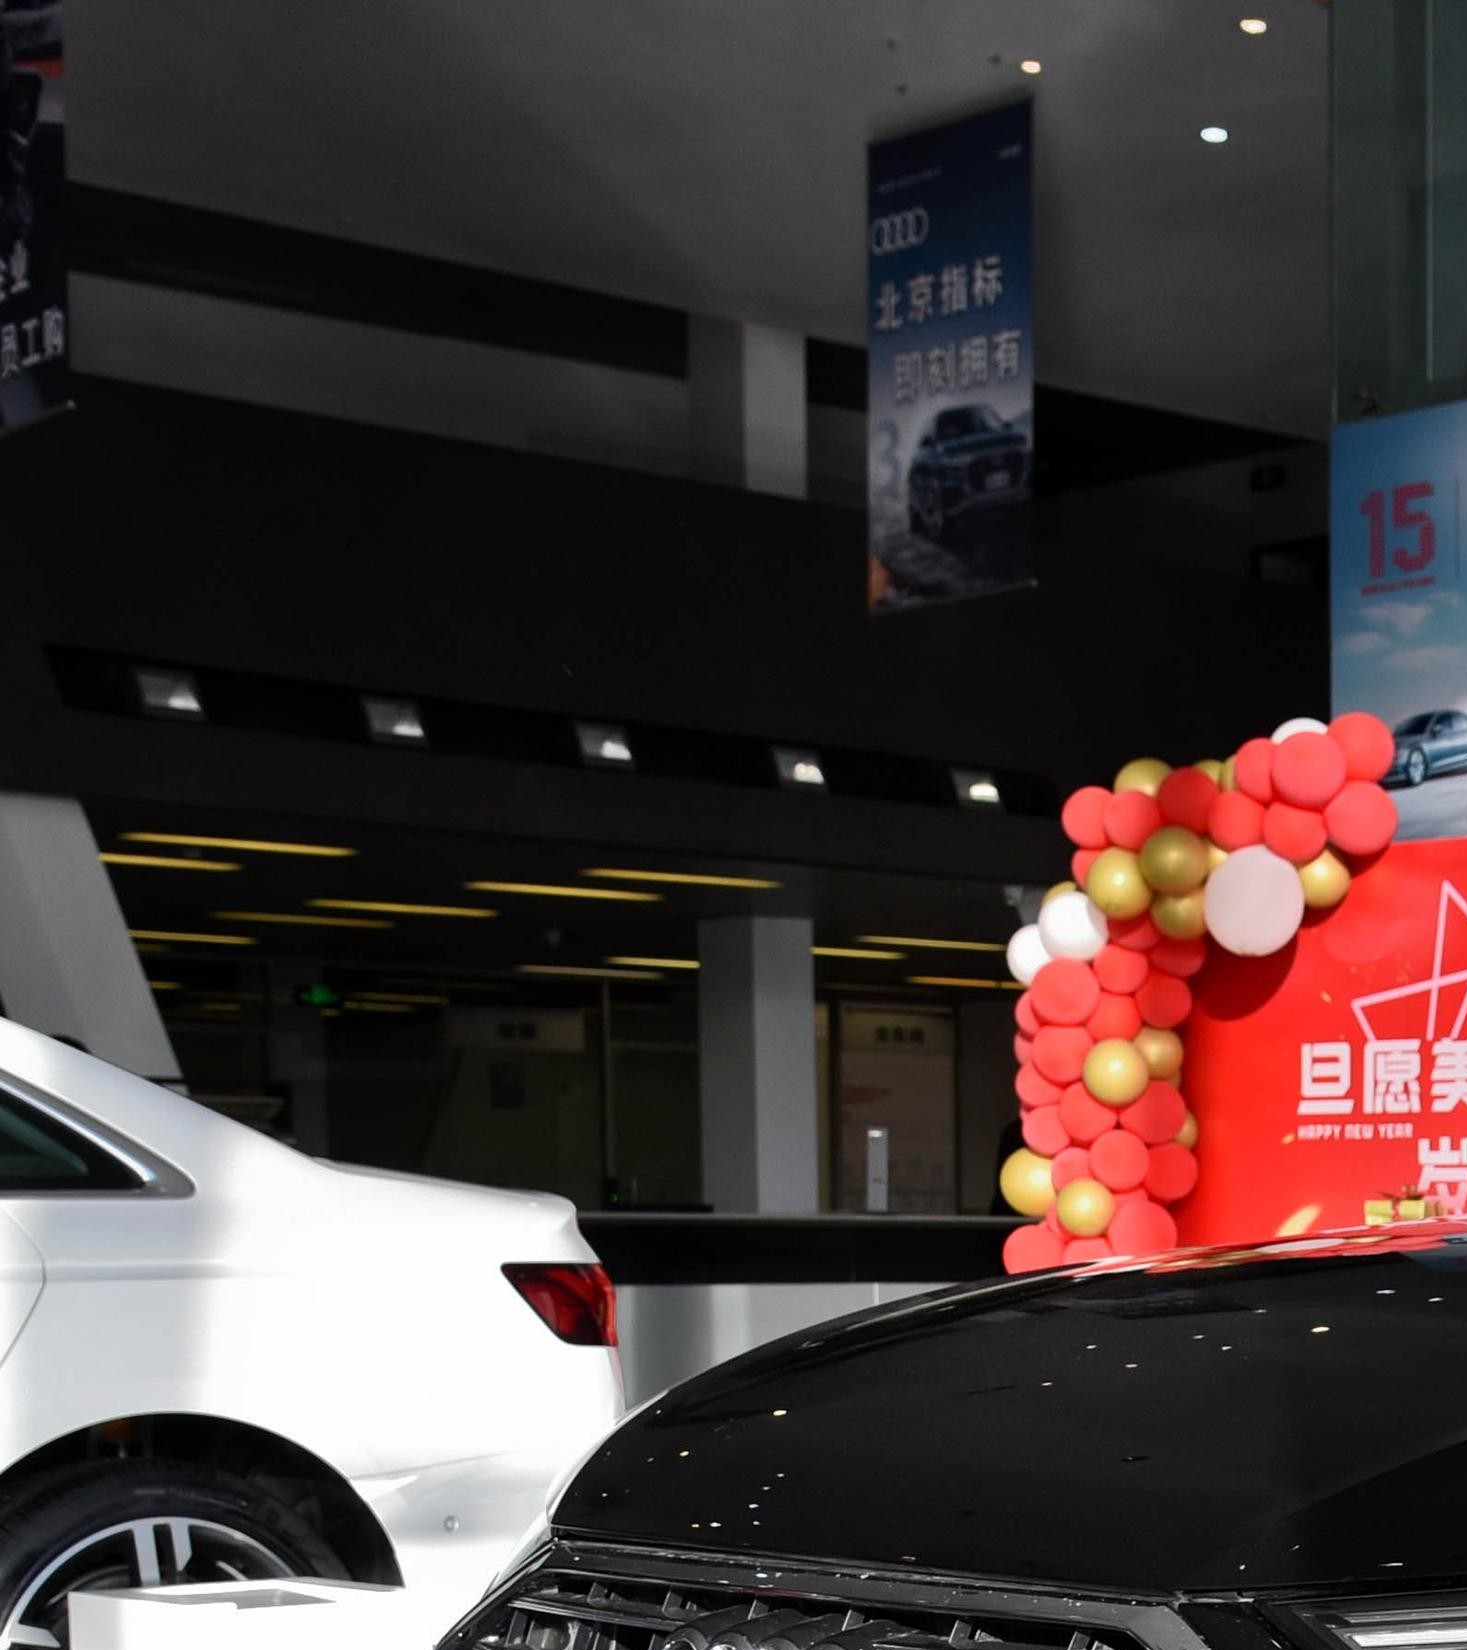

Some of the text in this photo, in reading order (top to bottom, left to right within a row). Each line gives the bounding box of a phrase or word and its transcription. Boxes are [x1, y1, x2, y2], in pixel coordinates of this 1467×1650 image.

[874, 256, 1002, 333] 北京指标
[894, 329, 1022, 405] 即刻拥有
[1359, 483, 1435, 577] 15
[1297, 1122, 1413, 1141] HAPPY NEW YEAR
